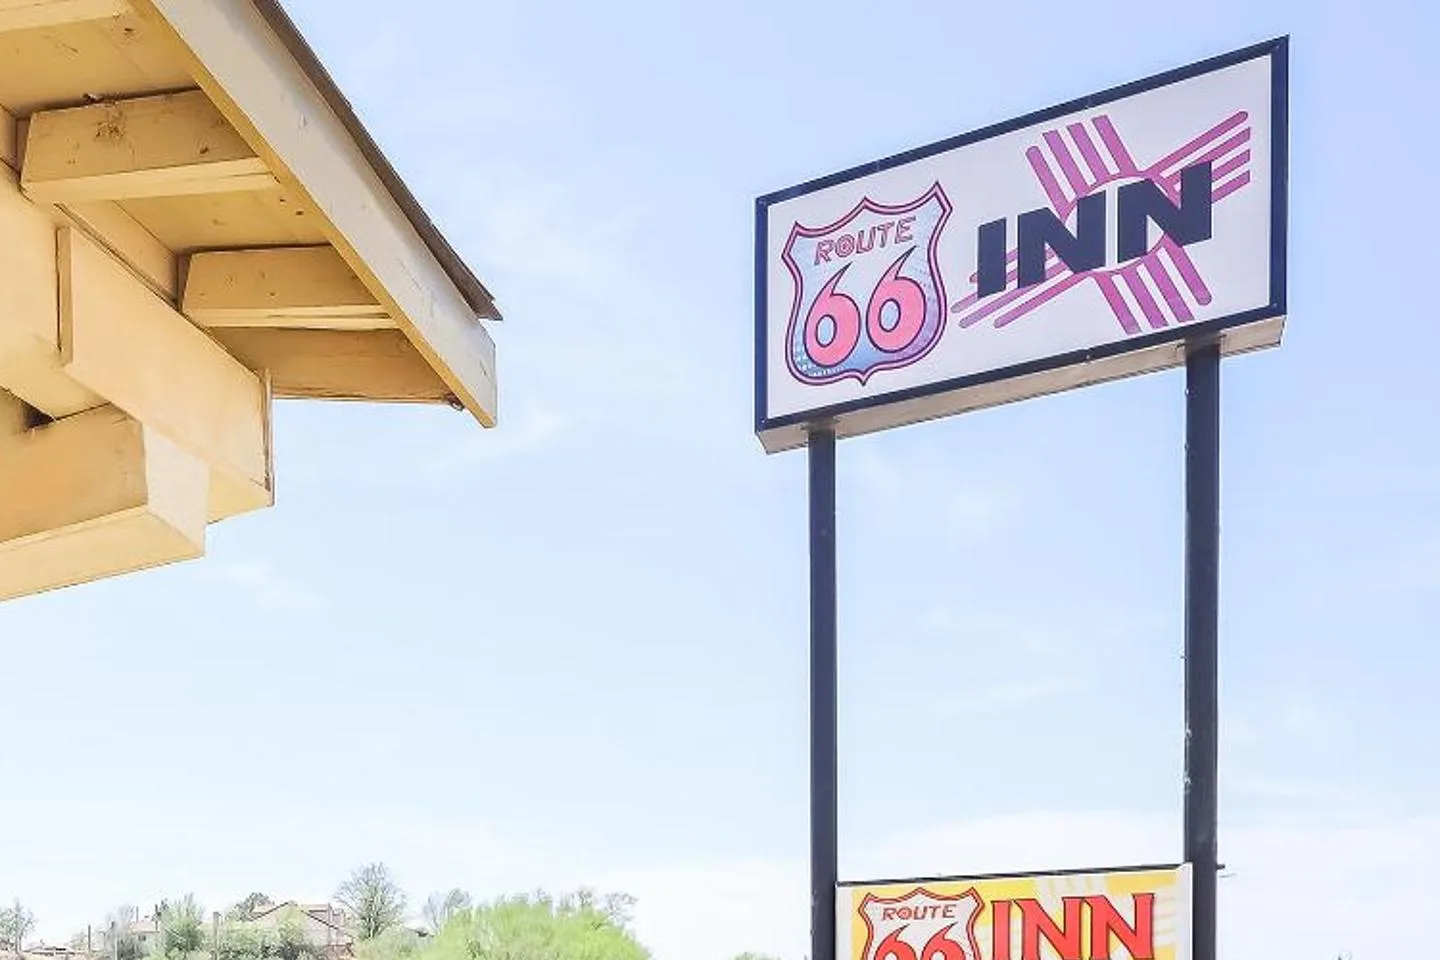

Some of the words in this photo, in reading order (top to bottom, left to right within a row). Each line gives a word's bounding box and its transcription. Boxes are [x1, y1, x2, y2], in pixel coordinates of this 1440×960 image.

[814, 216, 917, 266] ROUTE
[977, 160, 1213, 300] INN
[803, 245, 927, 368] 66
[881, 904, 957, 921] ROUTE
